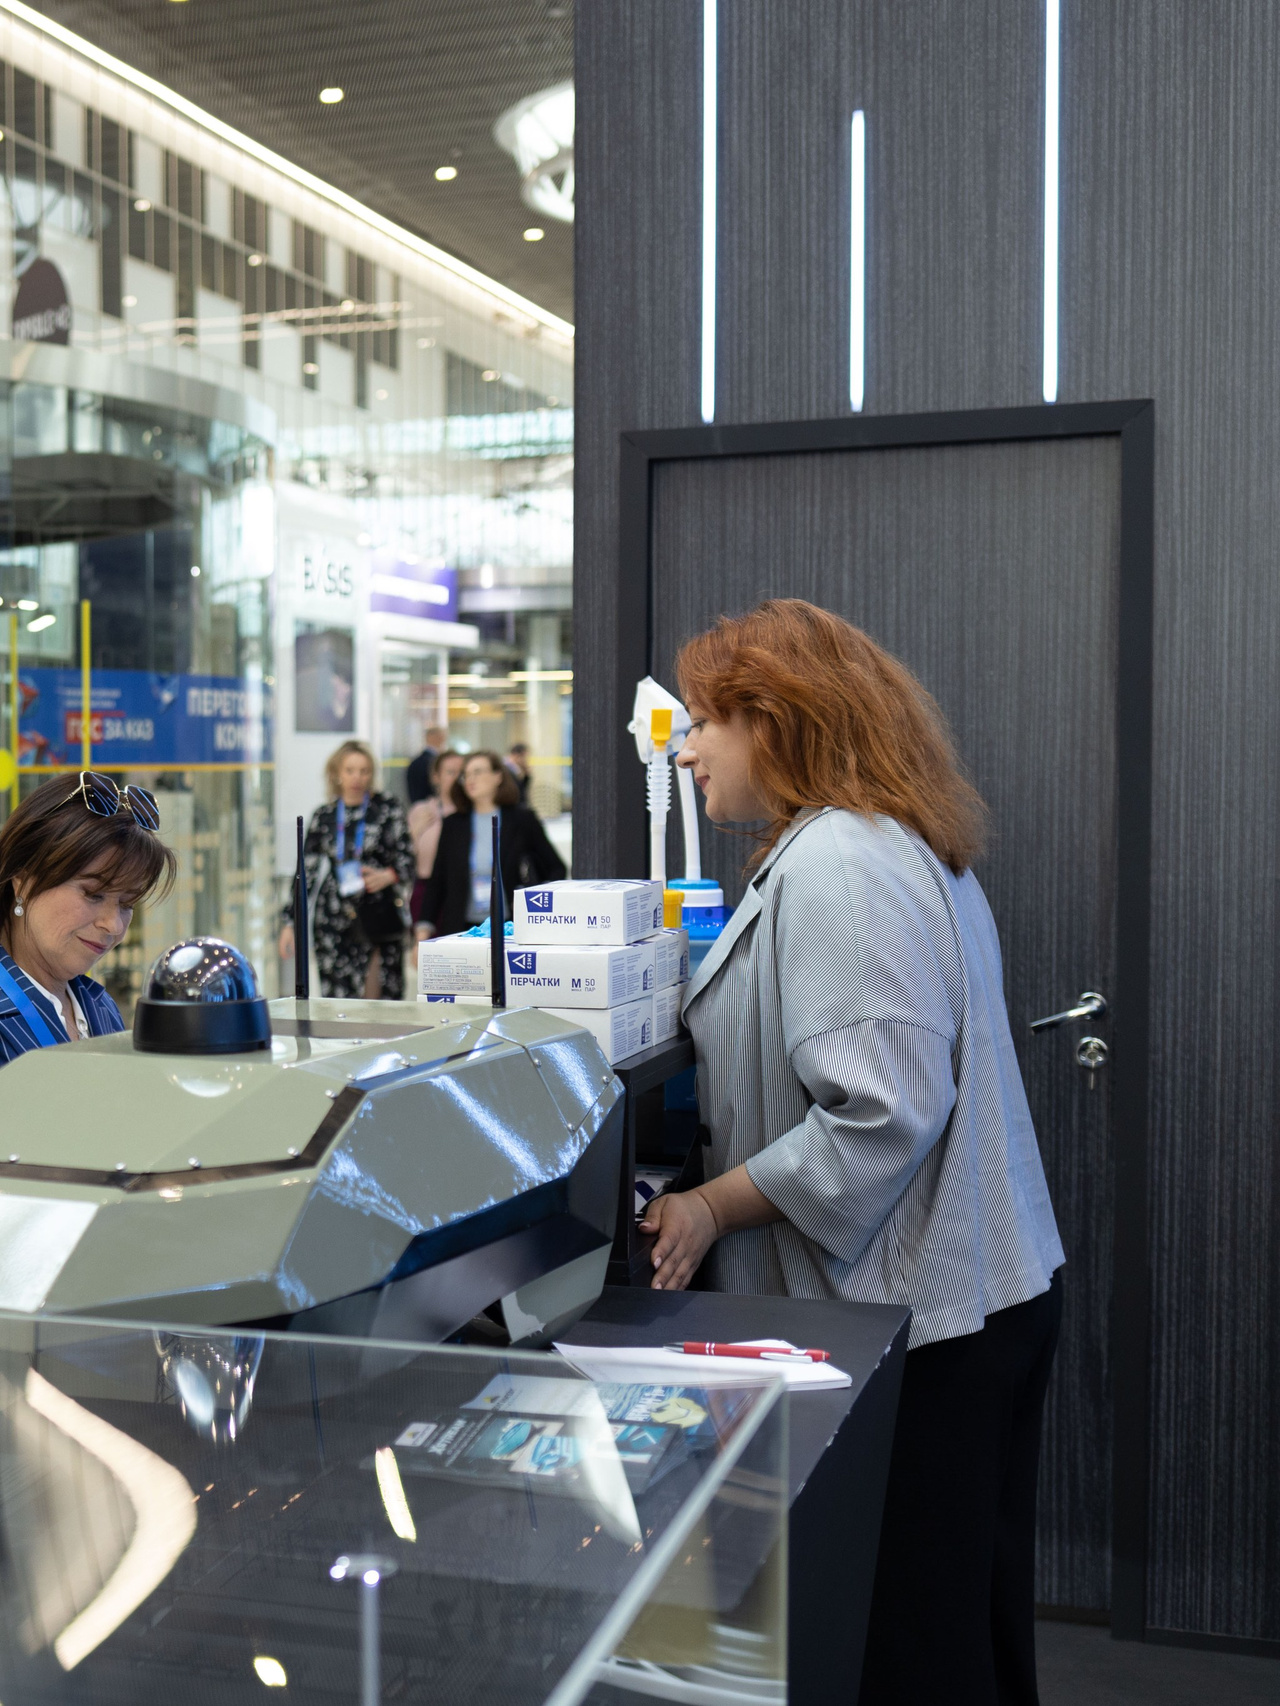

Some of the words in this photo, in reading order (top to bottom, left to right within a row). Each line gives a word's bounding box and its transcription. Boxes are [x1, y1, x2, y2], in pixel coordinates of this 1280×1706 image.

[527, 915, 577, 925] ПЕРЧАТКИ
[587, 915, 597, 926] M
[600, 915, 611, 924] 50
[510, 976, 560, 987] ПЕРЧАТКИ
[571, 978, 582, 989] M
[585, 978, 596, 987] 50
